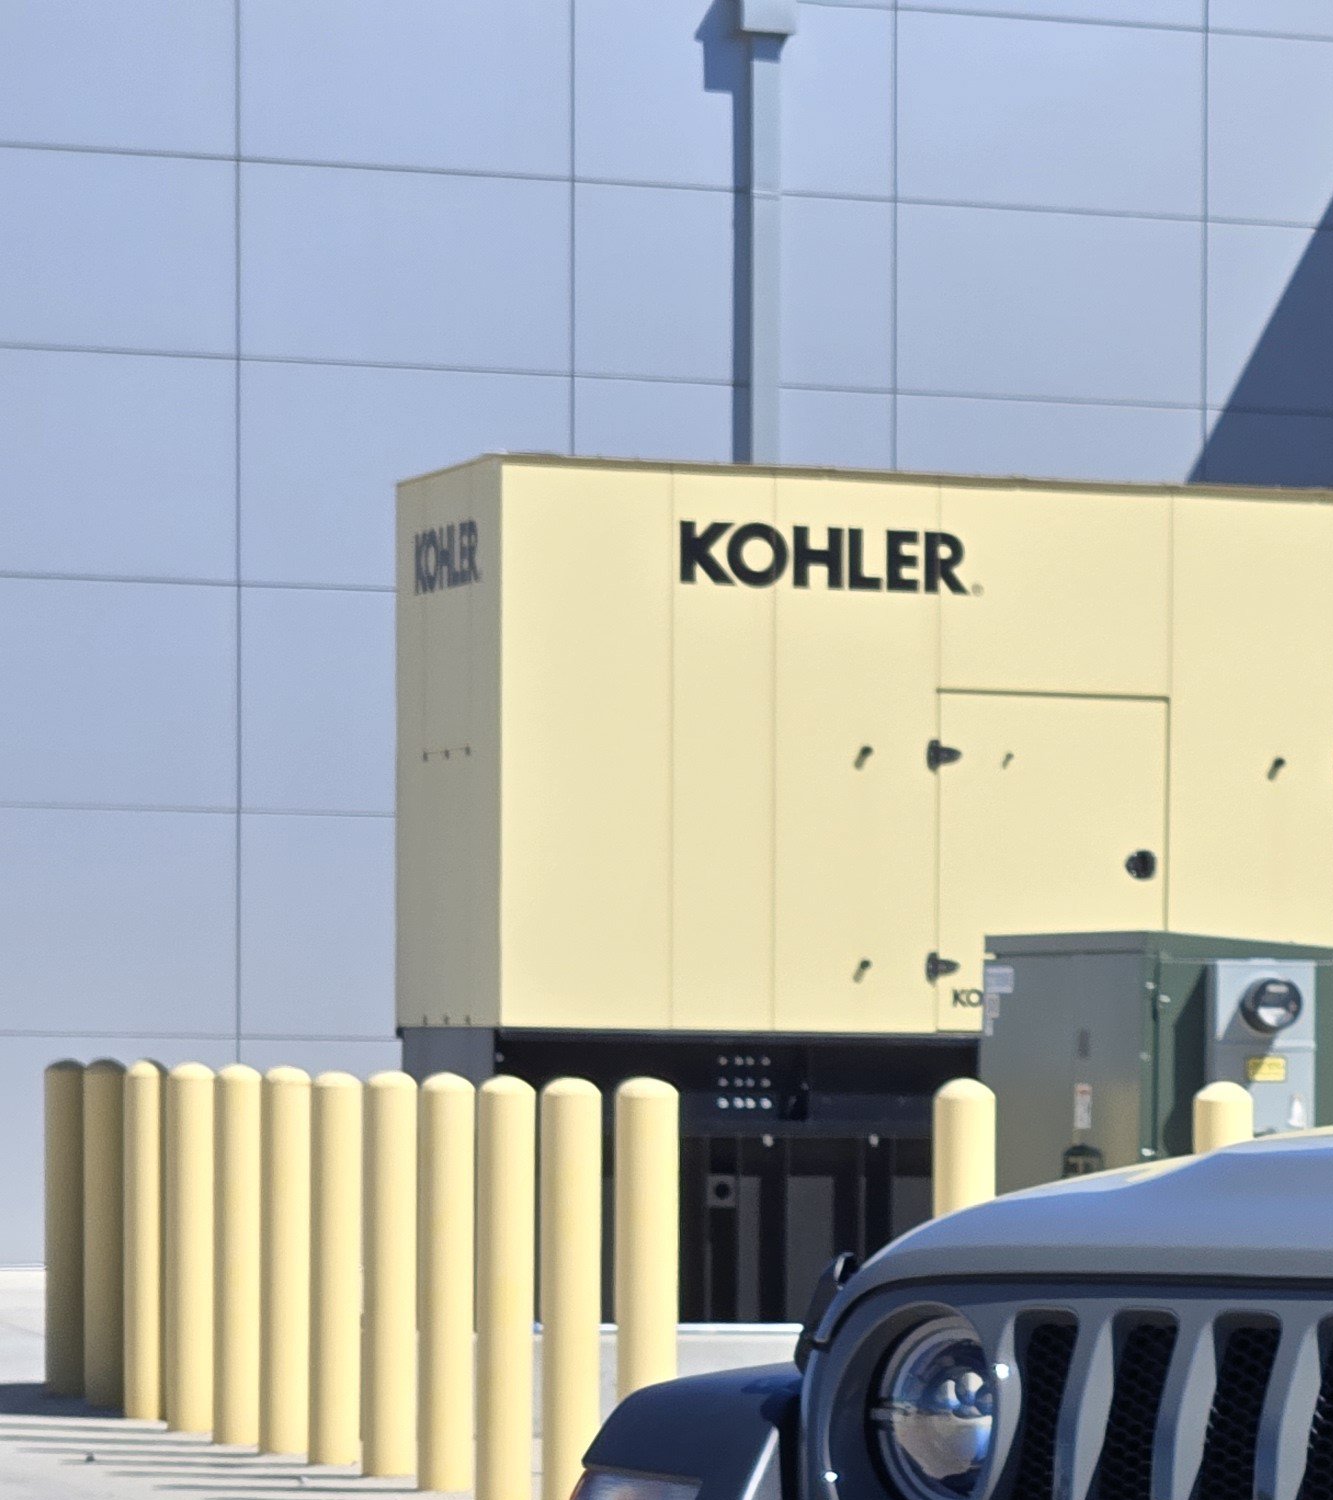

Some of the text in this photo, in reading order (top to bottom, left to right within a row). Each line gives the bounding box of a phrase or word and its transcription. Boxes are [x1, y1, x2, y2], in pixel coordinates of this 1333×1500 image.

[413, 519, 480, 596] KOHLER
[679, 520, 969, 595] KOHLER
[952, 988, 983, 1008] KO
